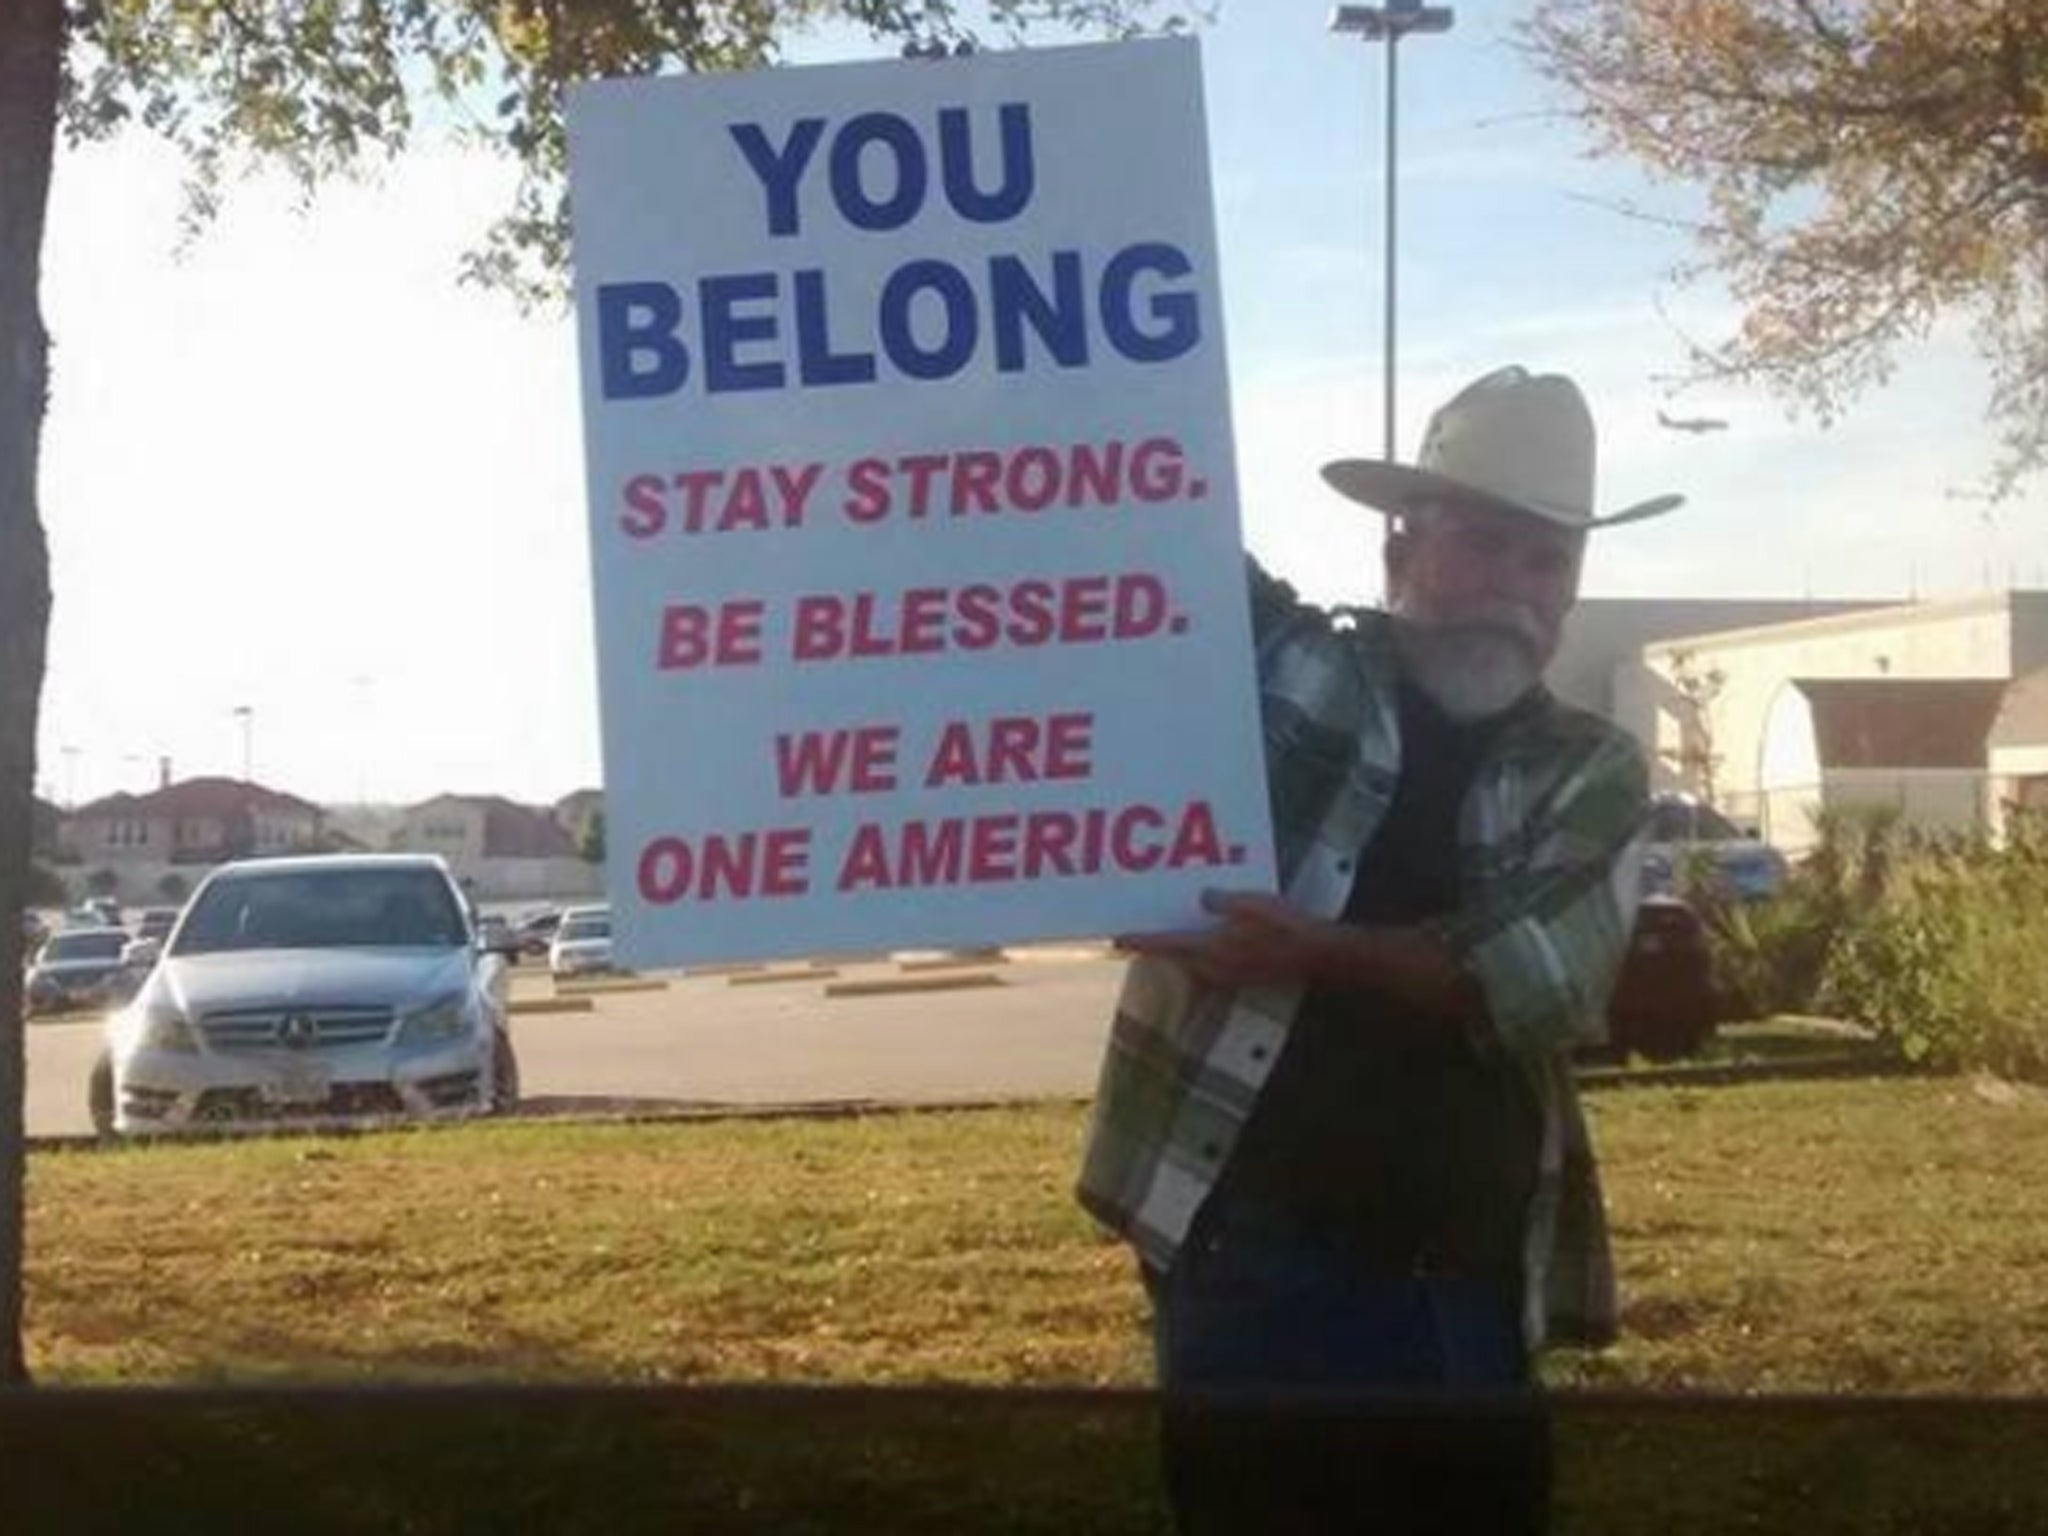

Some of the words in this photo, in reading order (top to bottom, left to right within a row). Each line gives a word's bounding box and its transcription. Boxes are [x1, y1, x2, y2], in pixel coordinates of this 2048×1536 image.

[730, 103, 1035, 236] YOU
[597, 242, 1201, 400] BELONG
[619, 463, 826, 540] STAY
[844, 439, 1208, 524] STRONG.
[657, 600, 763, 670] BE
[792, 572, 1190, 661] BLESSED.
[774, 726, 900, 798] WE
[925, 714, 1095, 786] ARE
[637, 828, 811, 905] ONE
[838, 802, 1246, 890] AMERICA.
